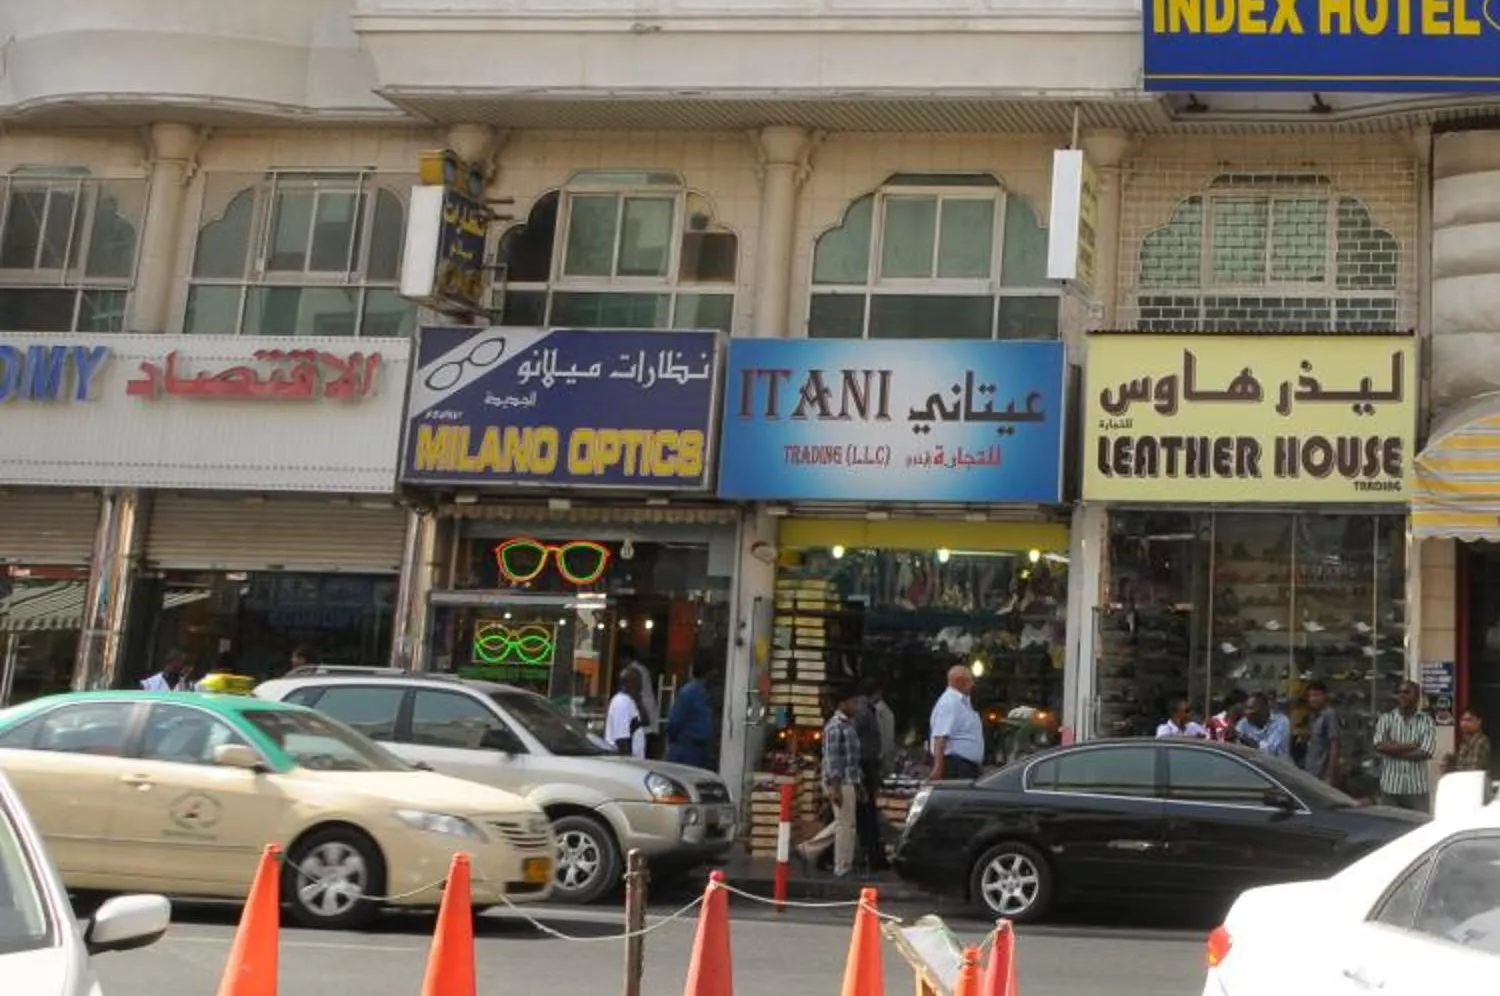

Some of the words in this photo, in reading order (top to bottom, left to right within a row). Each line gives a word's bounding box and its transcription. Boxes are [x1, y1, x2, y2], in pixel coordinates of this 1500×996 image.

[517, 347, 602, 389] ميلانو
[609, 350, 712, 388] نظارات
[738, 368, 894, 422] ITANI
[1099, 348, 1264, 417] هاوس
[1274, 349, 1405, 416] ليذر
[907, 370, 1046, 436] عيتاني
[414, 423, 560, 475] MILANO
[567, 427, 705, 478] OPTICS
[783, 445, 843, 465] TRADING
[1097, 435, 1264, 479] LEATHER
[1273, 435, 1405, 479] HOUSE
